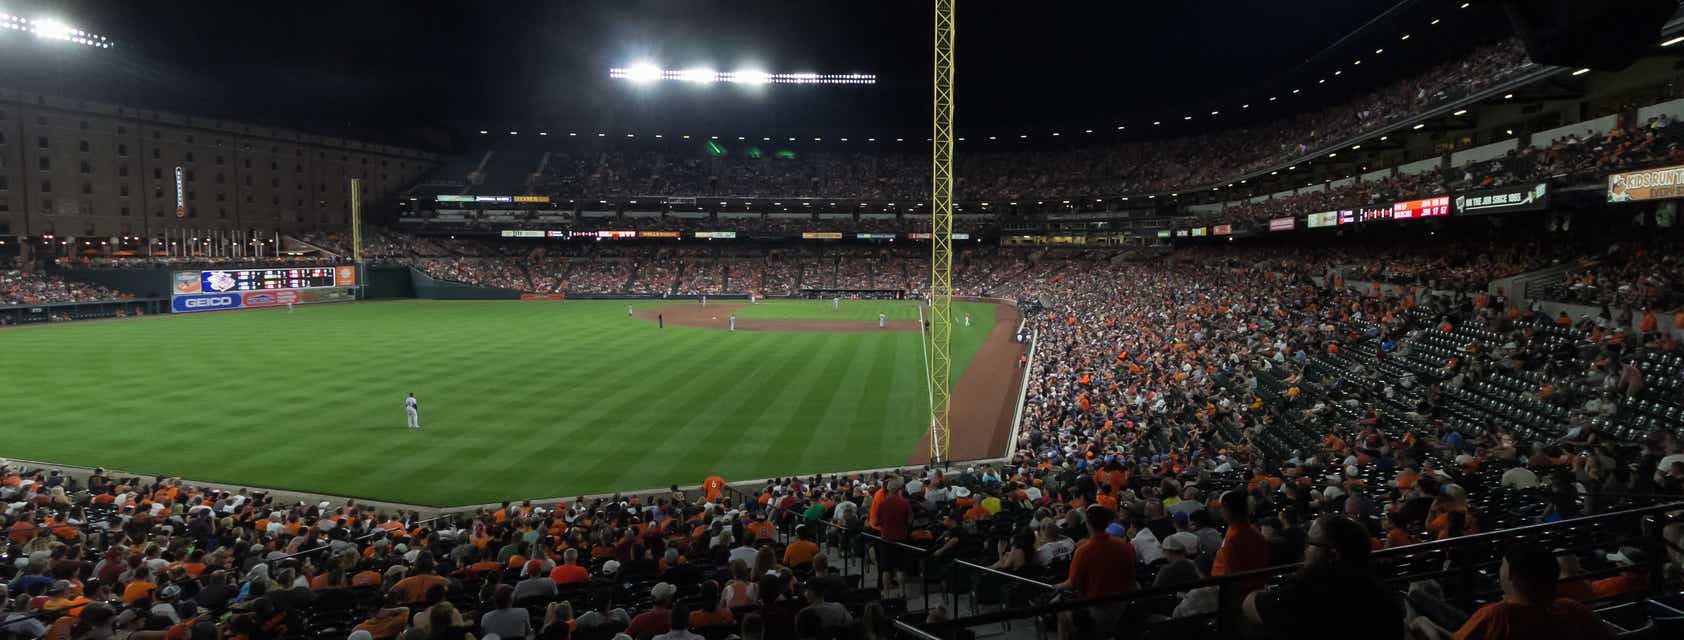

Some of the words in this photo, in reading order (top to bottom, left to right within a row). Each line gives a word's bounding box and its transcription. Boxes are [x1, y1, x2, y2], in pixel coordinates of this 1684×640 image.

[1627, 174, 1650, 188] KIDS
[1650, 170, 1674, 186] RUN
[185, 297, 232, 308] GEICO
